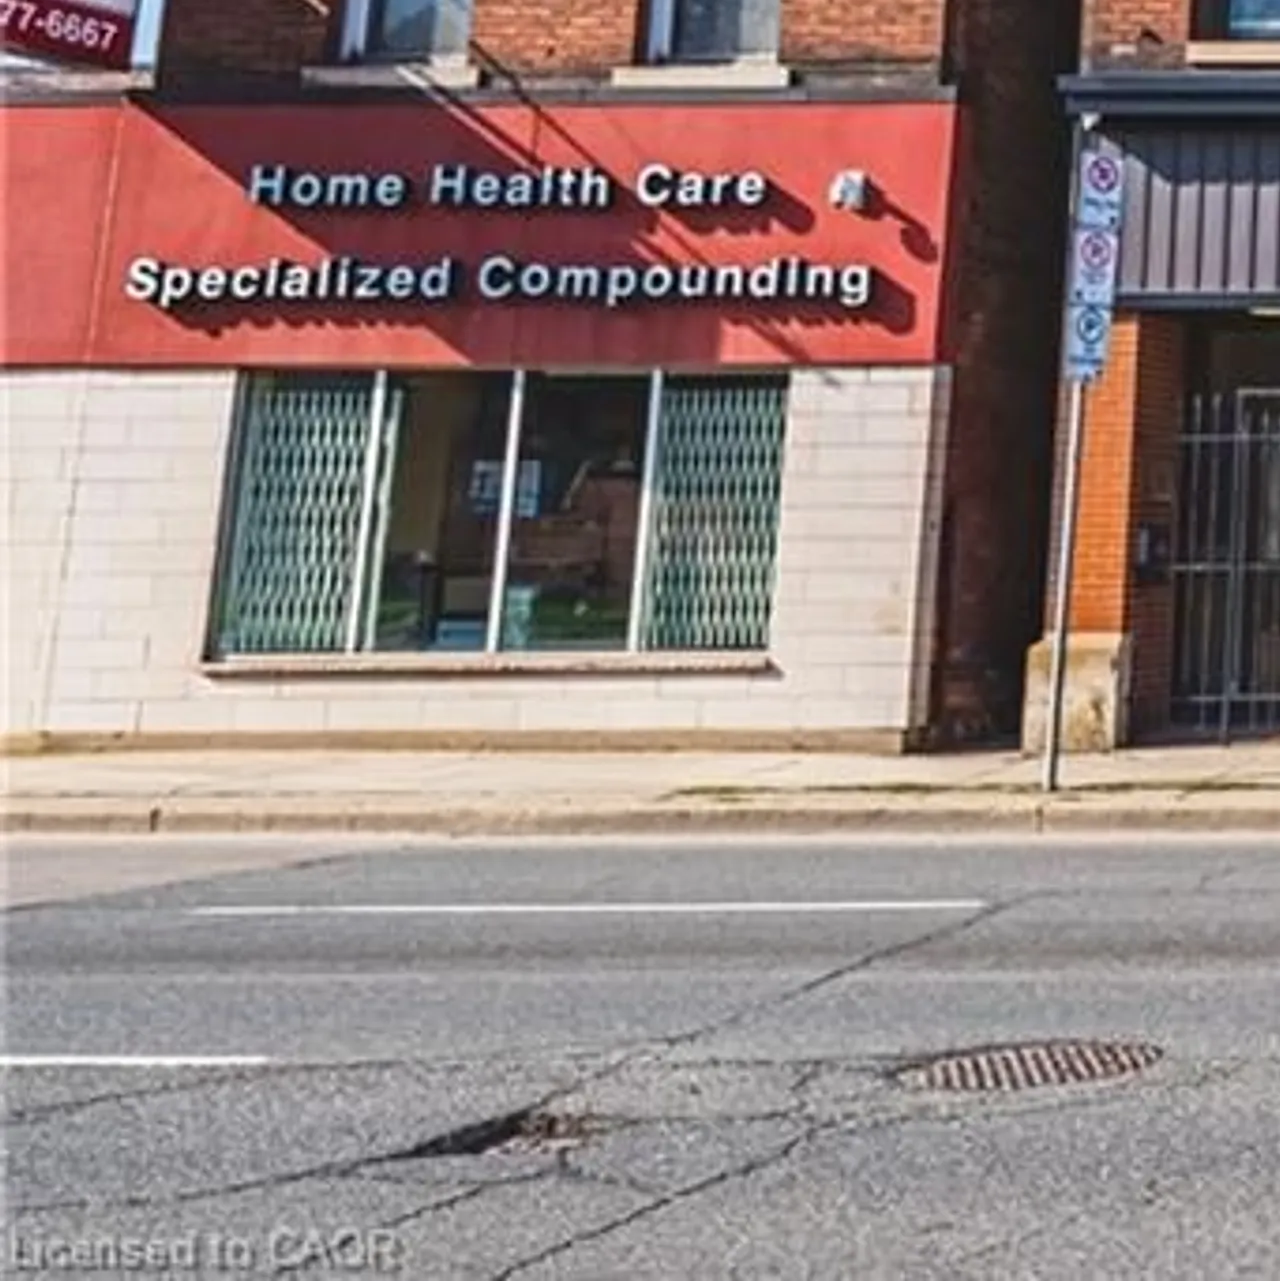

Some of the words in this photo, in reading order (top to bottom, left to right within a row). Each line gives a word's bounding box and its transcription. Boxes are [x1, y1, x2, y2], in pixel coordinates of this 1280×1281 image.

[250, 165, 405, 207] Home
[430, 165, 610, 207] Health
[636, 163, 765, 206] Care
[124, 257, 452, 308] Specialized
[478, 256, 870, 307] Compounding
